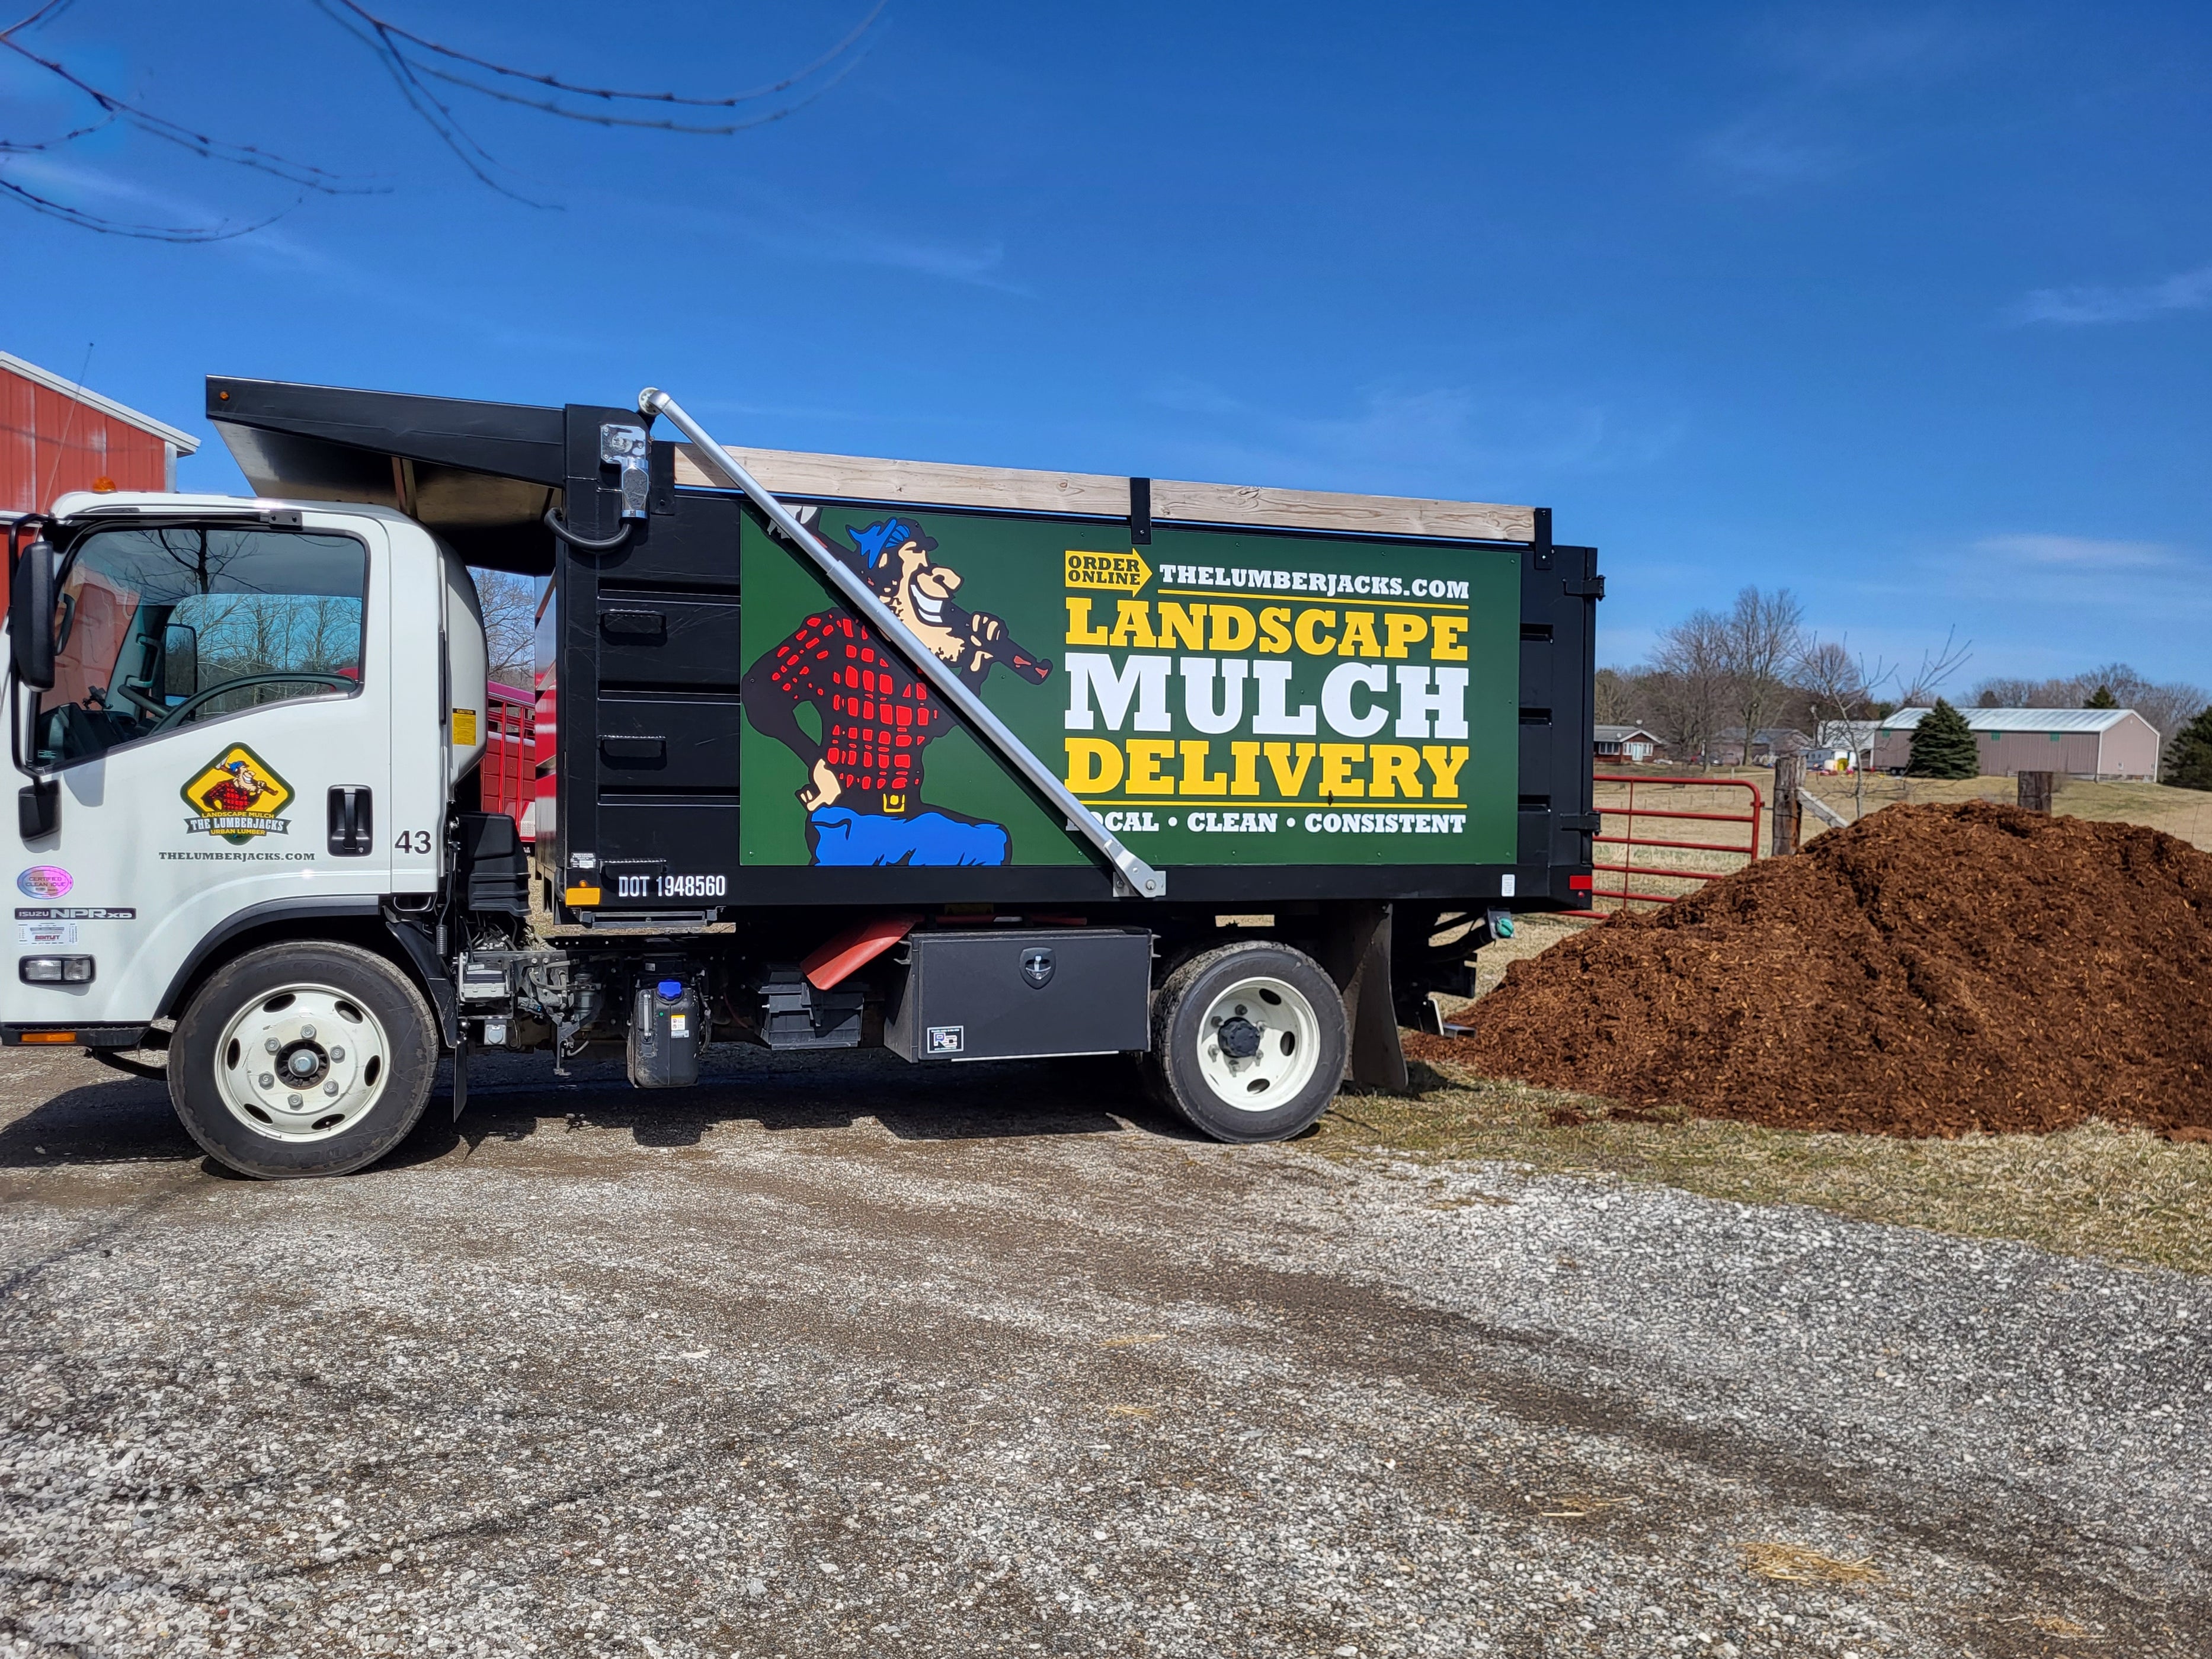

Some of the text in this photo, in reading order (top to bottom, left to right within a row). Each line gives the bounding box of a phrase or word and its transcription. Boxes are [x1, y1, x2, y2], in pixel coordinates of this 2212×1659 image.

[1068, 555, 1140, 572] ORDER
[1068, 569, 1141, 585] ONLINE
[1160, 565, 1469, 599] THELUMBERJACKS.COM
[1065, 597, 1468, 661] LANDSCAPE
[1065, 652, 1469, 739] MULCH
[1065, 738, 1470, 798] DELIVERY
[190, 818, 284, 831] THE LUMBERJACKS
[1066, 811, 1466, 834] CAL CLEAN CONSISTENT
[394, 830, 431, 854] 43
[158, 851, 315, 863] THELUMBERJACKS.COM
[618, 875, 726, 897] DOT 1948560
